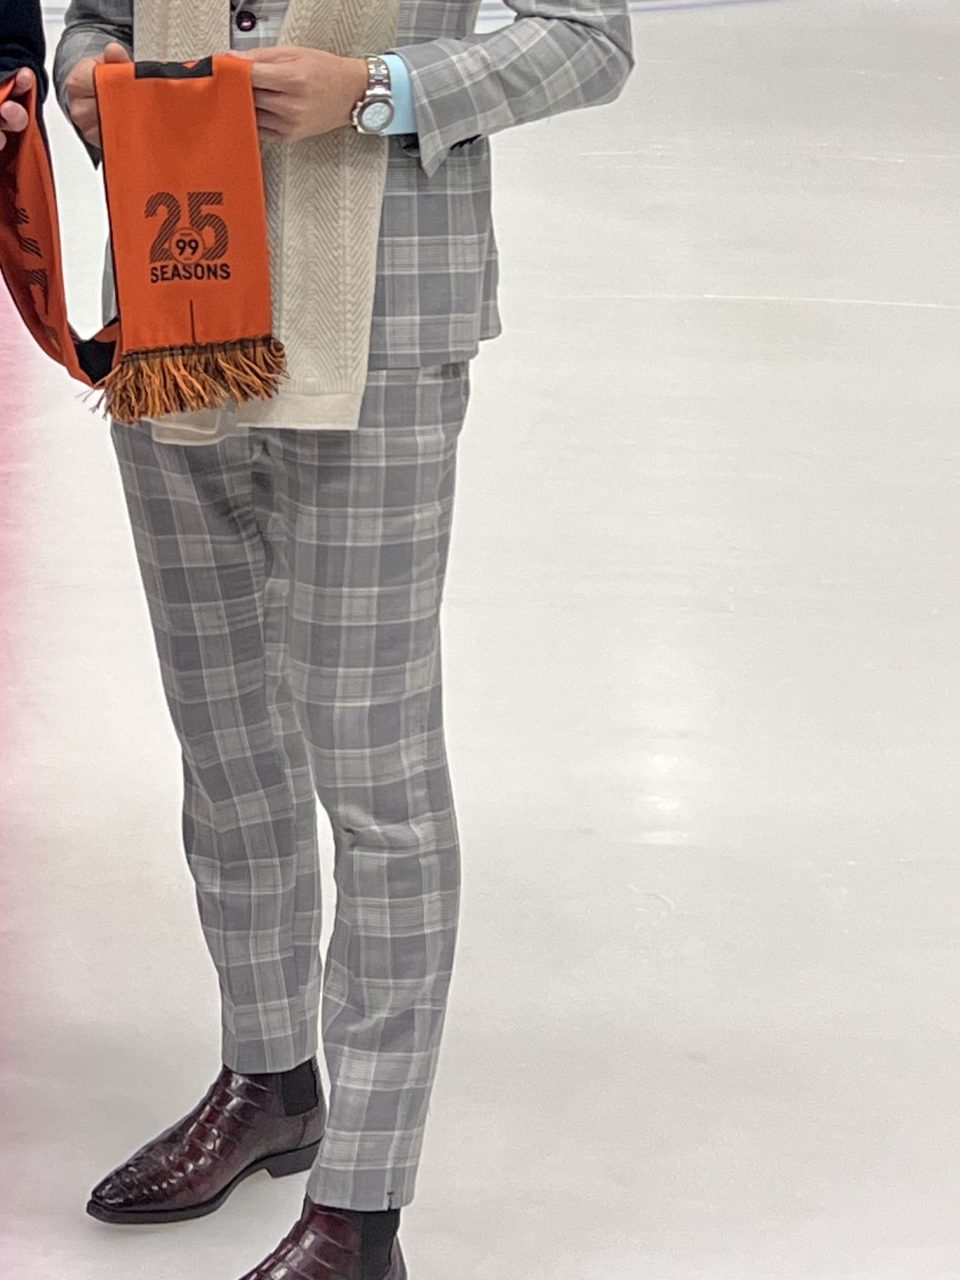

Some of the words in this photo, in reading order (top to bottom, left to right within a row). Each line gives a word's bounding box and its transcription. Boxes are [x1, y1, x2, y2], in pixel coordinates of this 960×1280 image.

[144, 191, 228, 264] 25
[176, 238, 199, 256] 99
[150, 263, 231, 284] SEASONS
